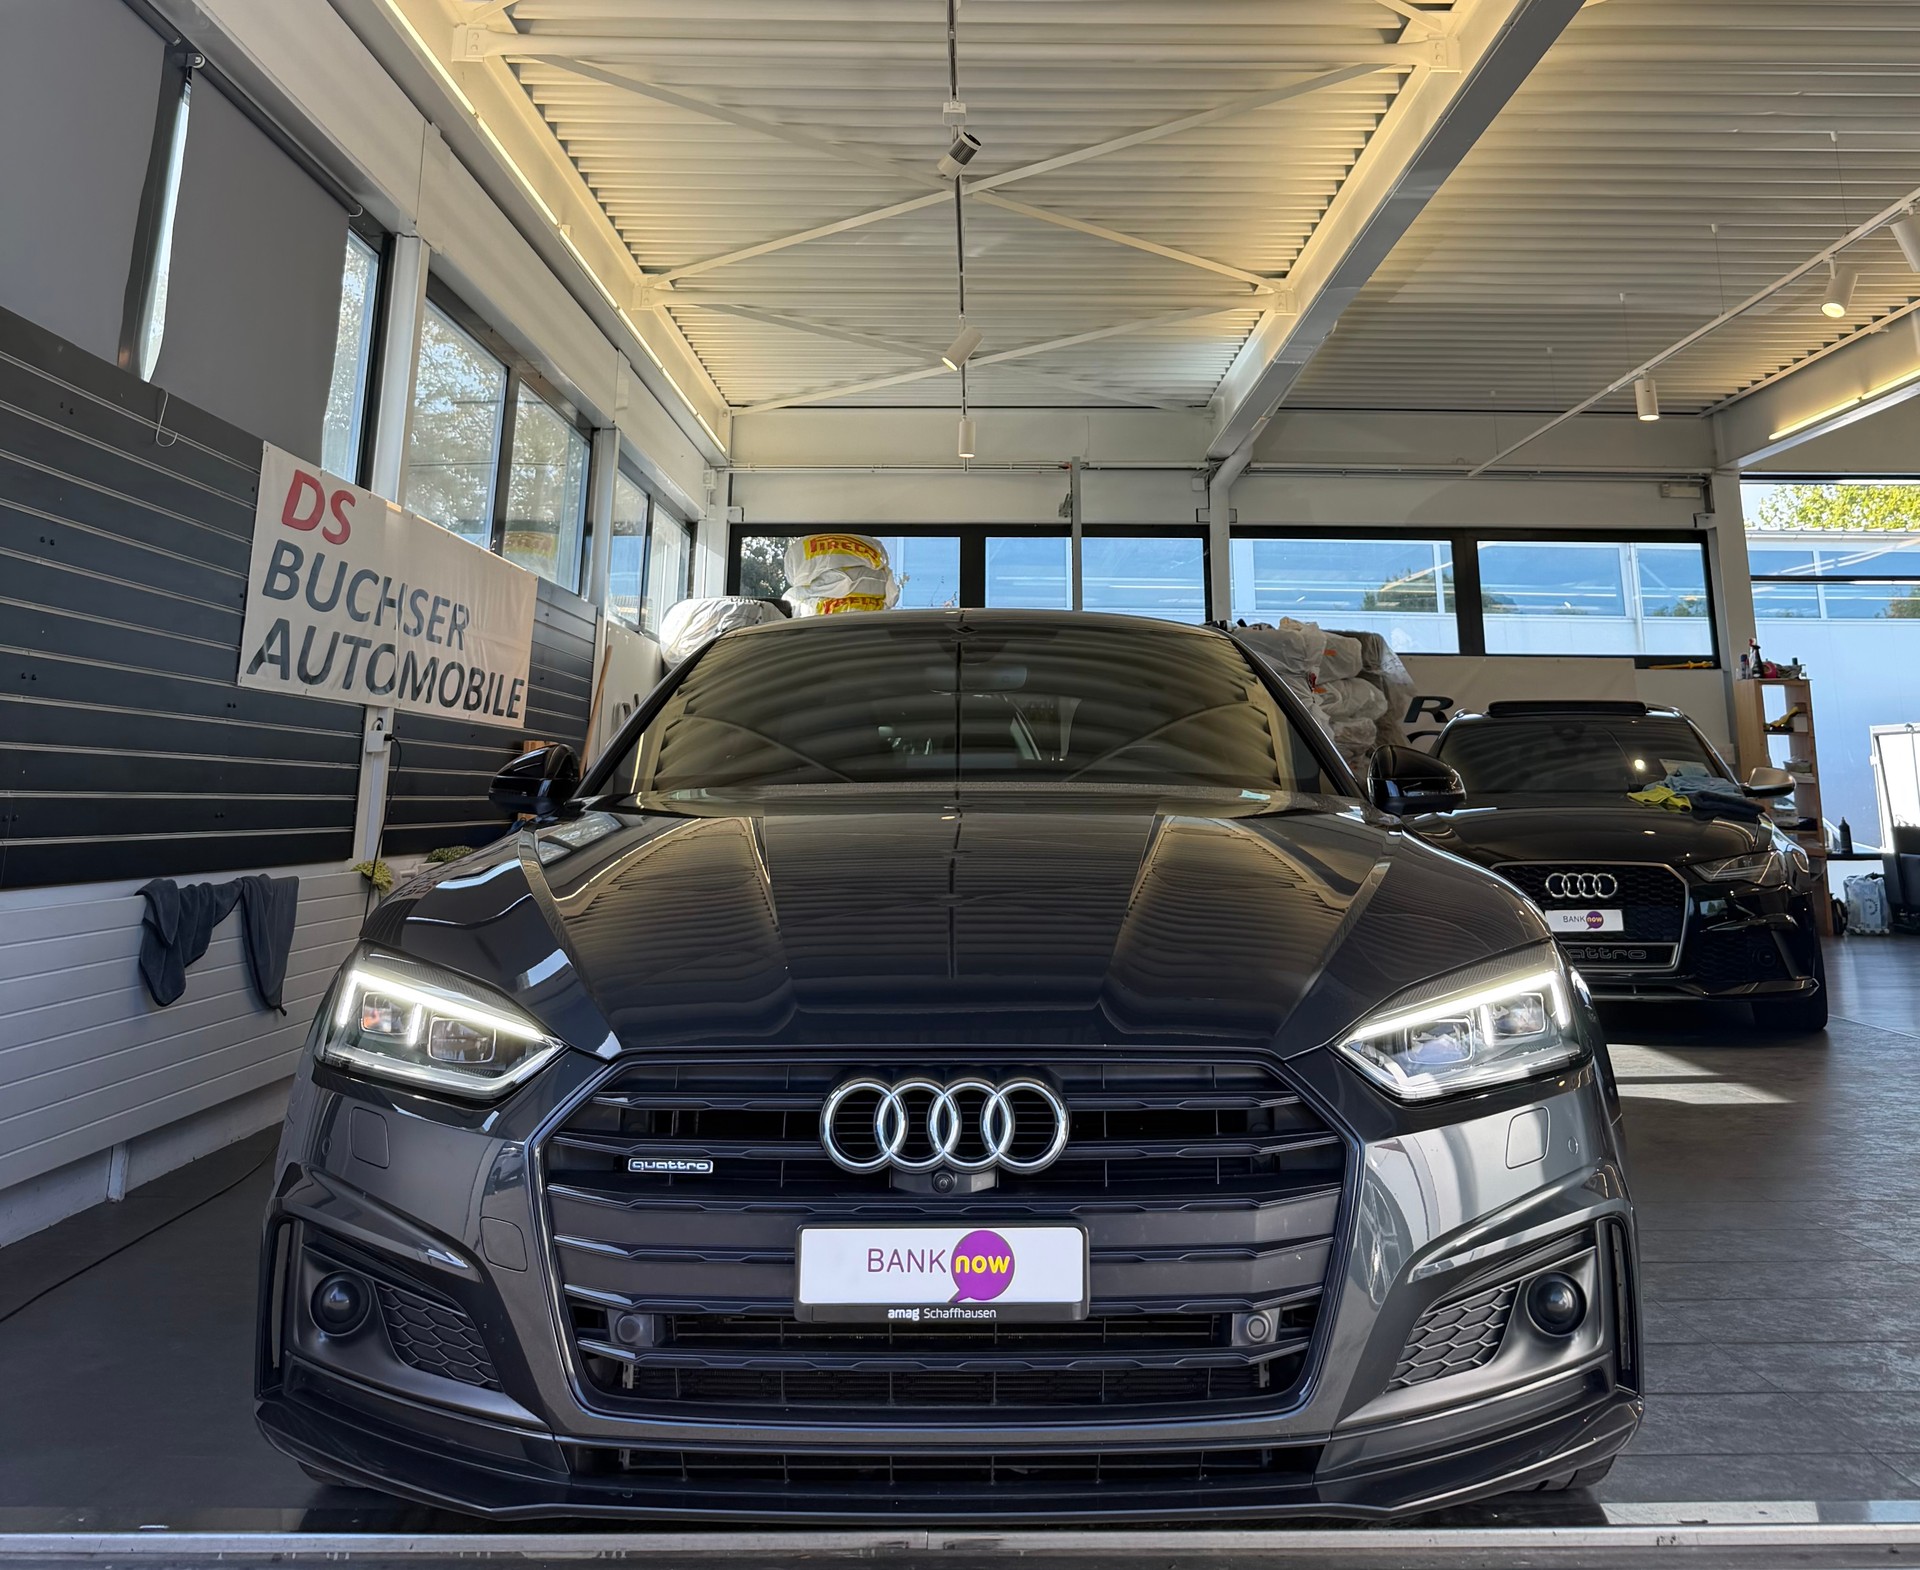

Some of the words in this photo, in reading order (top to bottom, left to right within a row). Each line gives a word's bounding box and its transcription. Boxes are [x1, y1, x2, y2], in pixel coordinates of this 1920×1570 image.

[281, 469, 356, 545] DS
[262, 539, 470, 650] BUCHSER
[246, 617, 525, 719] AUTOMOBILE
[1563, 915, 1585, 923] BANK
[1586, 915, 1603, 923] now
[1567, 947, 1647, 960] attro
[631, 1160, 709, 1171] quattro
[867, 1248, 947, 1273] BANK
[954, 1255, 1010, 1274] now
[887, 1308, 920, 1321] amag
[923, 1308, 996, 1319] Schaffhausen
